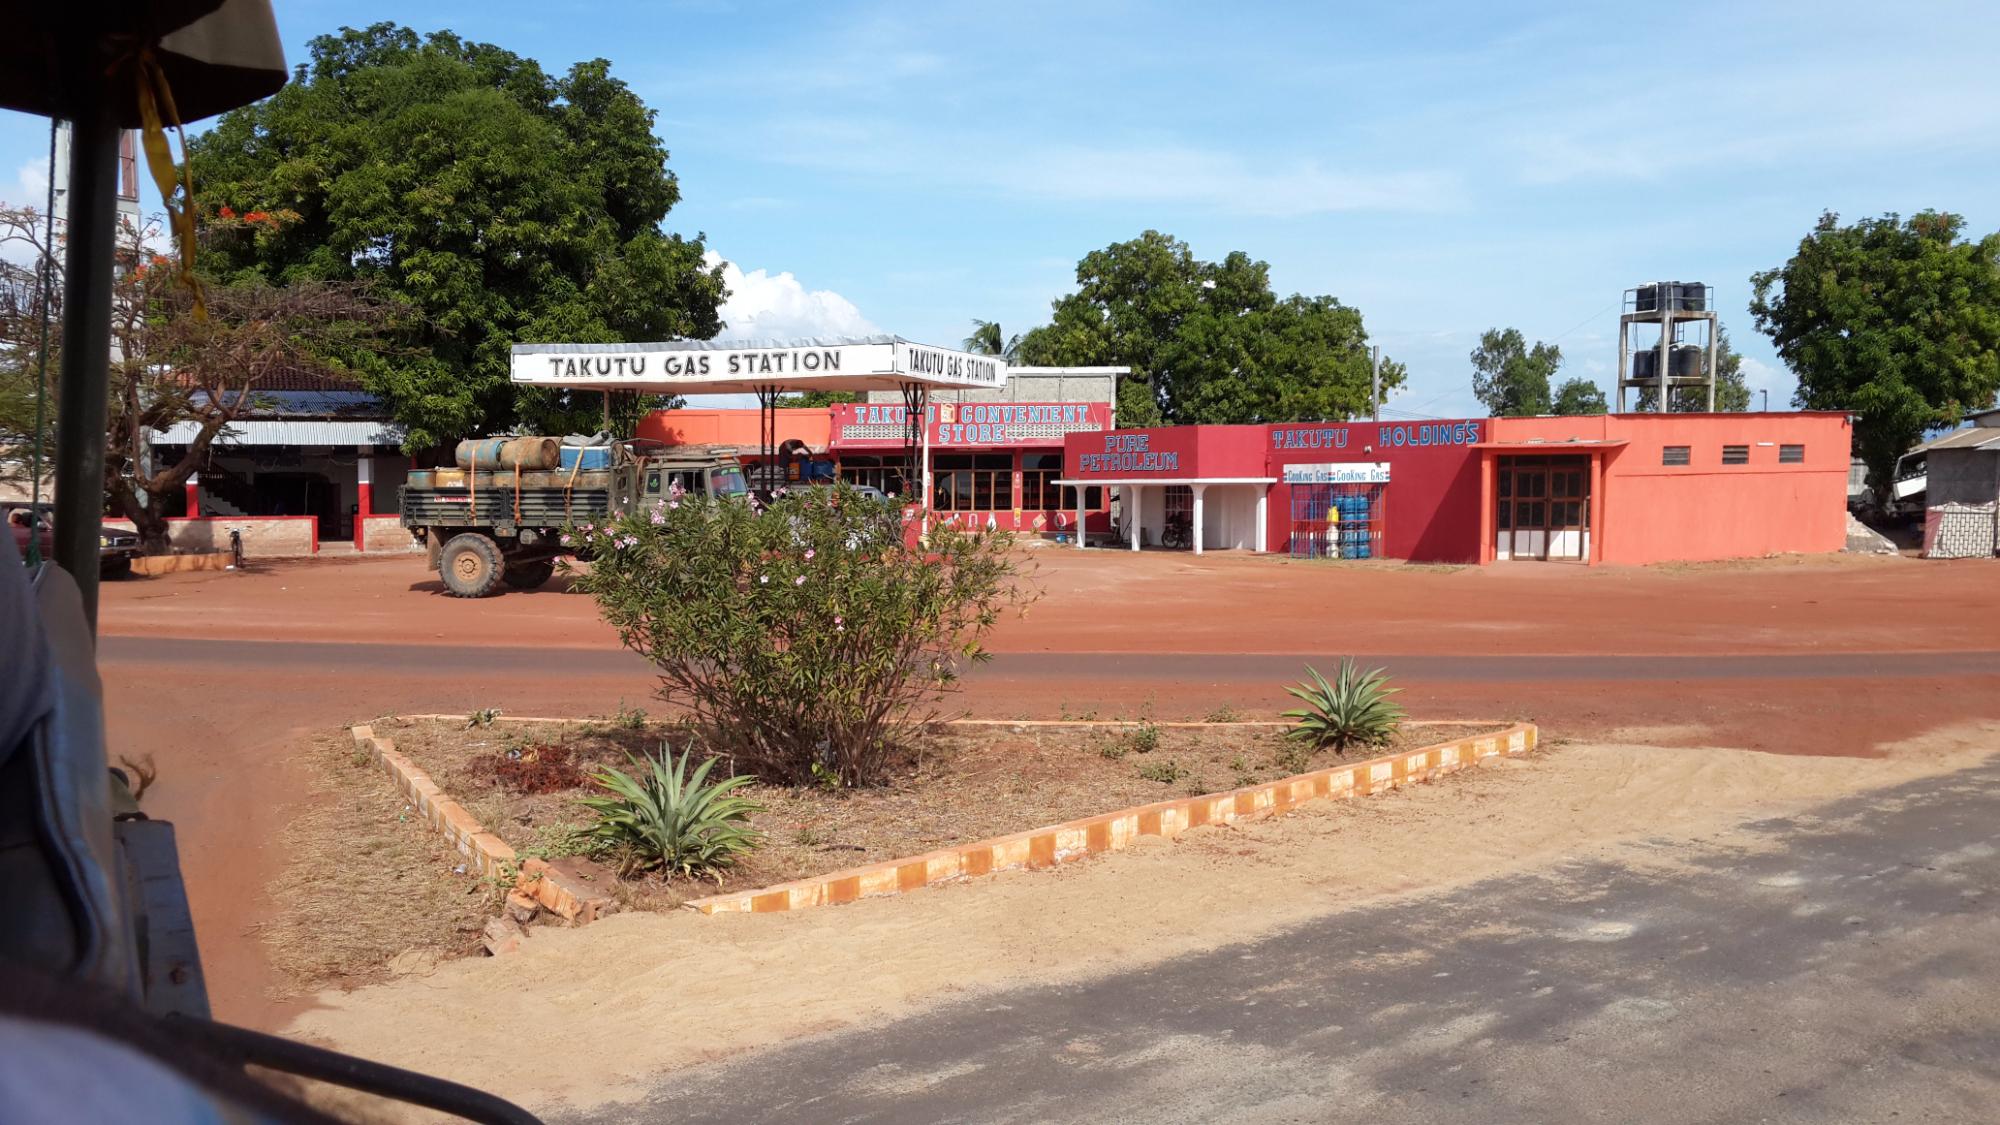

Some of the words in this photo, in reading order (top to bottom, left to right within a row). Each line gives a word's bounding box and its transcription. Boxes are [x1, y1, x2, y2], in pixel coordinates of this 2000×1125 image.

[549, 357, 646, 377] TAKUTU
[665, 356, 710, 375] GAS
[728, 350, 842, 374] STATION
[909, 348, 944, 375] TAKUTU
[947, 355, 962, 377] GAS
[967, 358, 996, 382] STATION
[855, 406, 936, 424] TAKUU
[961, 405, 1088, 424] CONVENIENT
[938, 424, 1005, 443] STORE
[1104, 434, 1149, 453] PURE
[1272, 428, 1349, 449] TAKUTU
[1080, 452, 1179, 472] PETROLEUM
